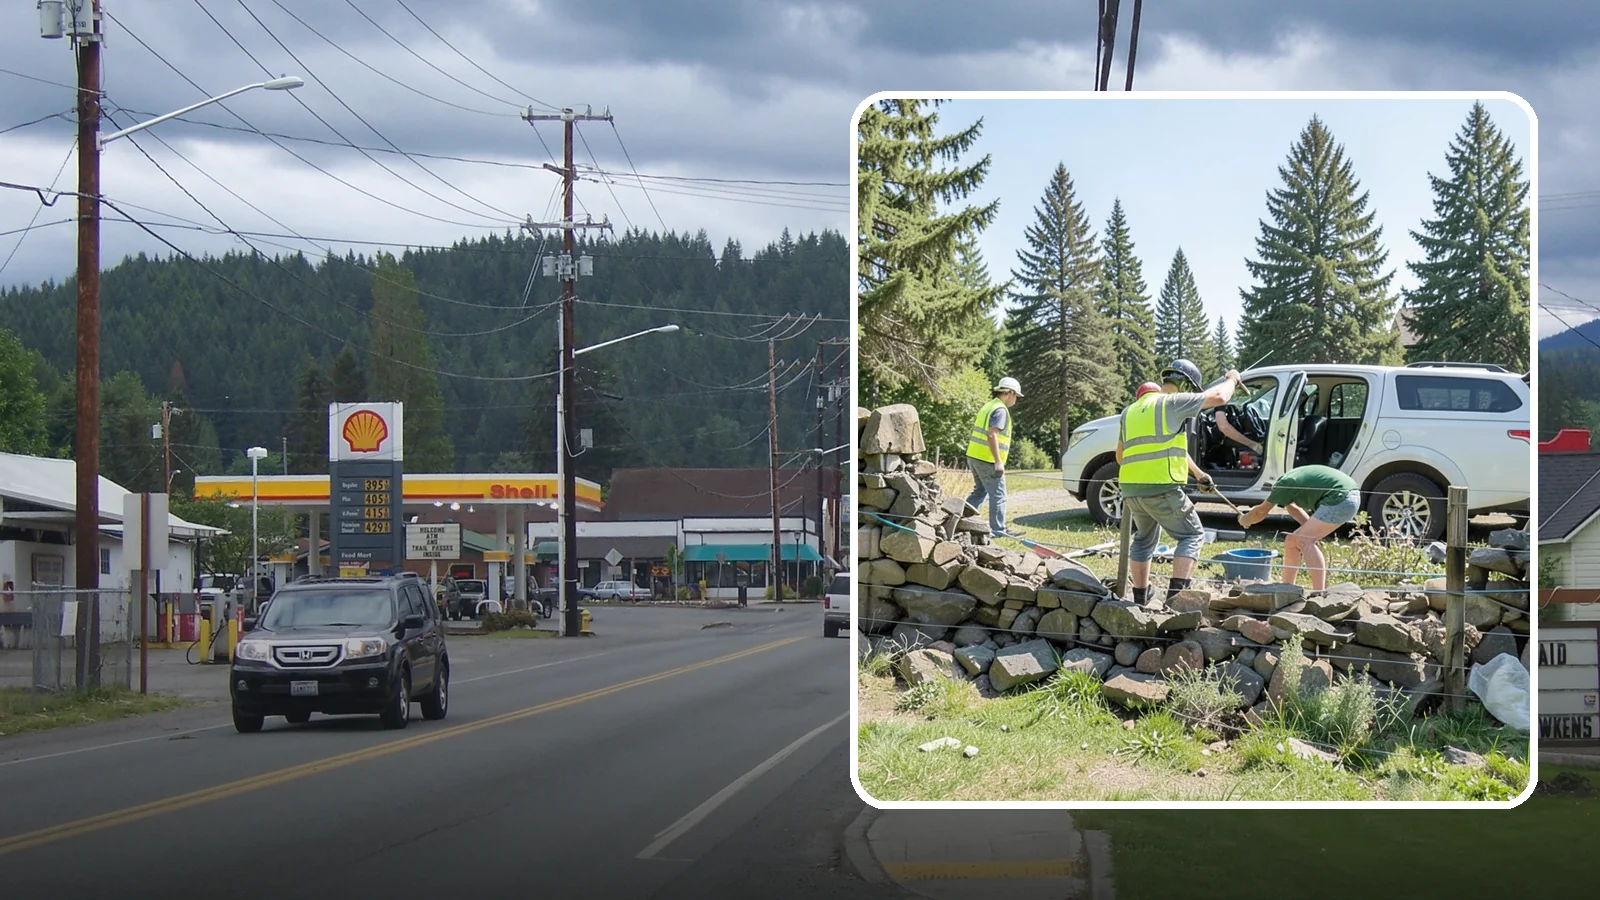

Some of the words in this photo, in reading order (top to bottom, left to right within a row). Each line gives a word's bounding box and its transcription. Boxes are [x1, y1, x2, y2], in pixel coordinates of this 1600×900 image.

[366, 480, 383, 490] 395
[490, 484, 547, 499] Shell
[366, 494, 383, 504] 405
[366, 508, 383, 518] 415
[366, 522, 383, 532] 429
